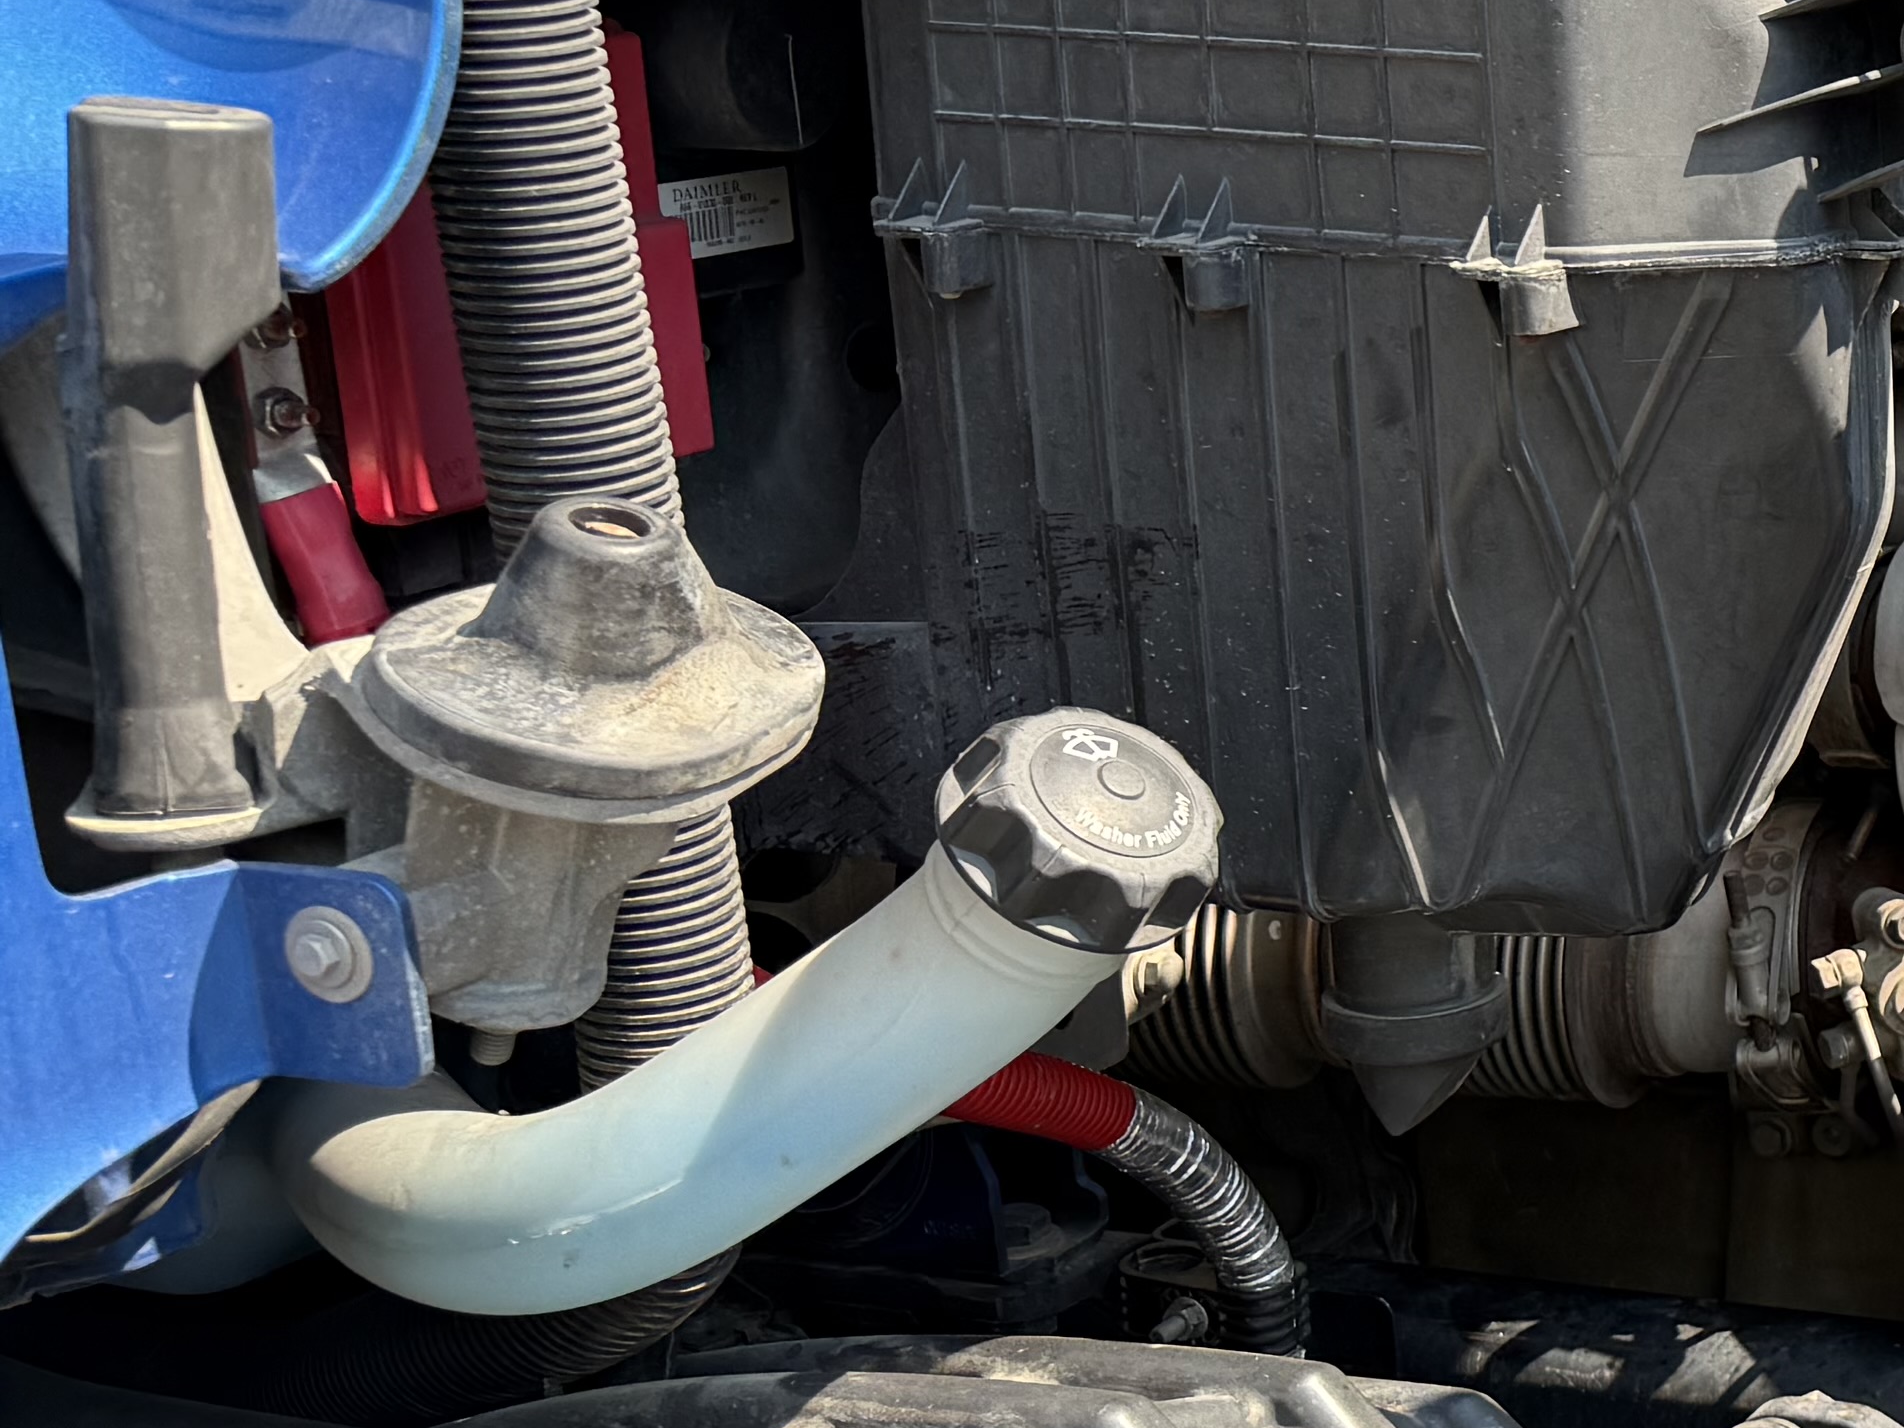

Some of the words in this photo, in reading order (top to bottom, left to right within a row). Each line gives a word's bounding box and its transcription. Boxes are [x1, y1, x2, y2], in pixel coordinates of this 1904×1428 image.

[671, 179, 742, 203] DAIMLER
[1075, 807, 1142, 849] Washer
[1144, 821, 1182, 849] Fluid
